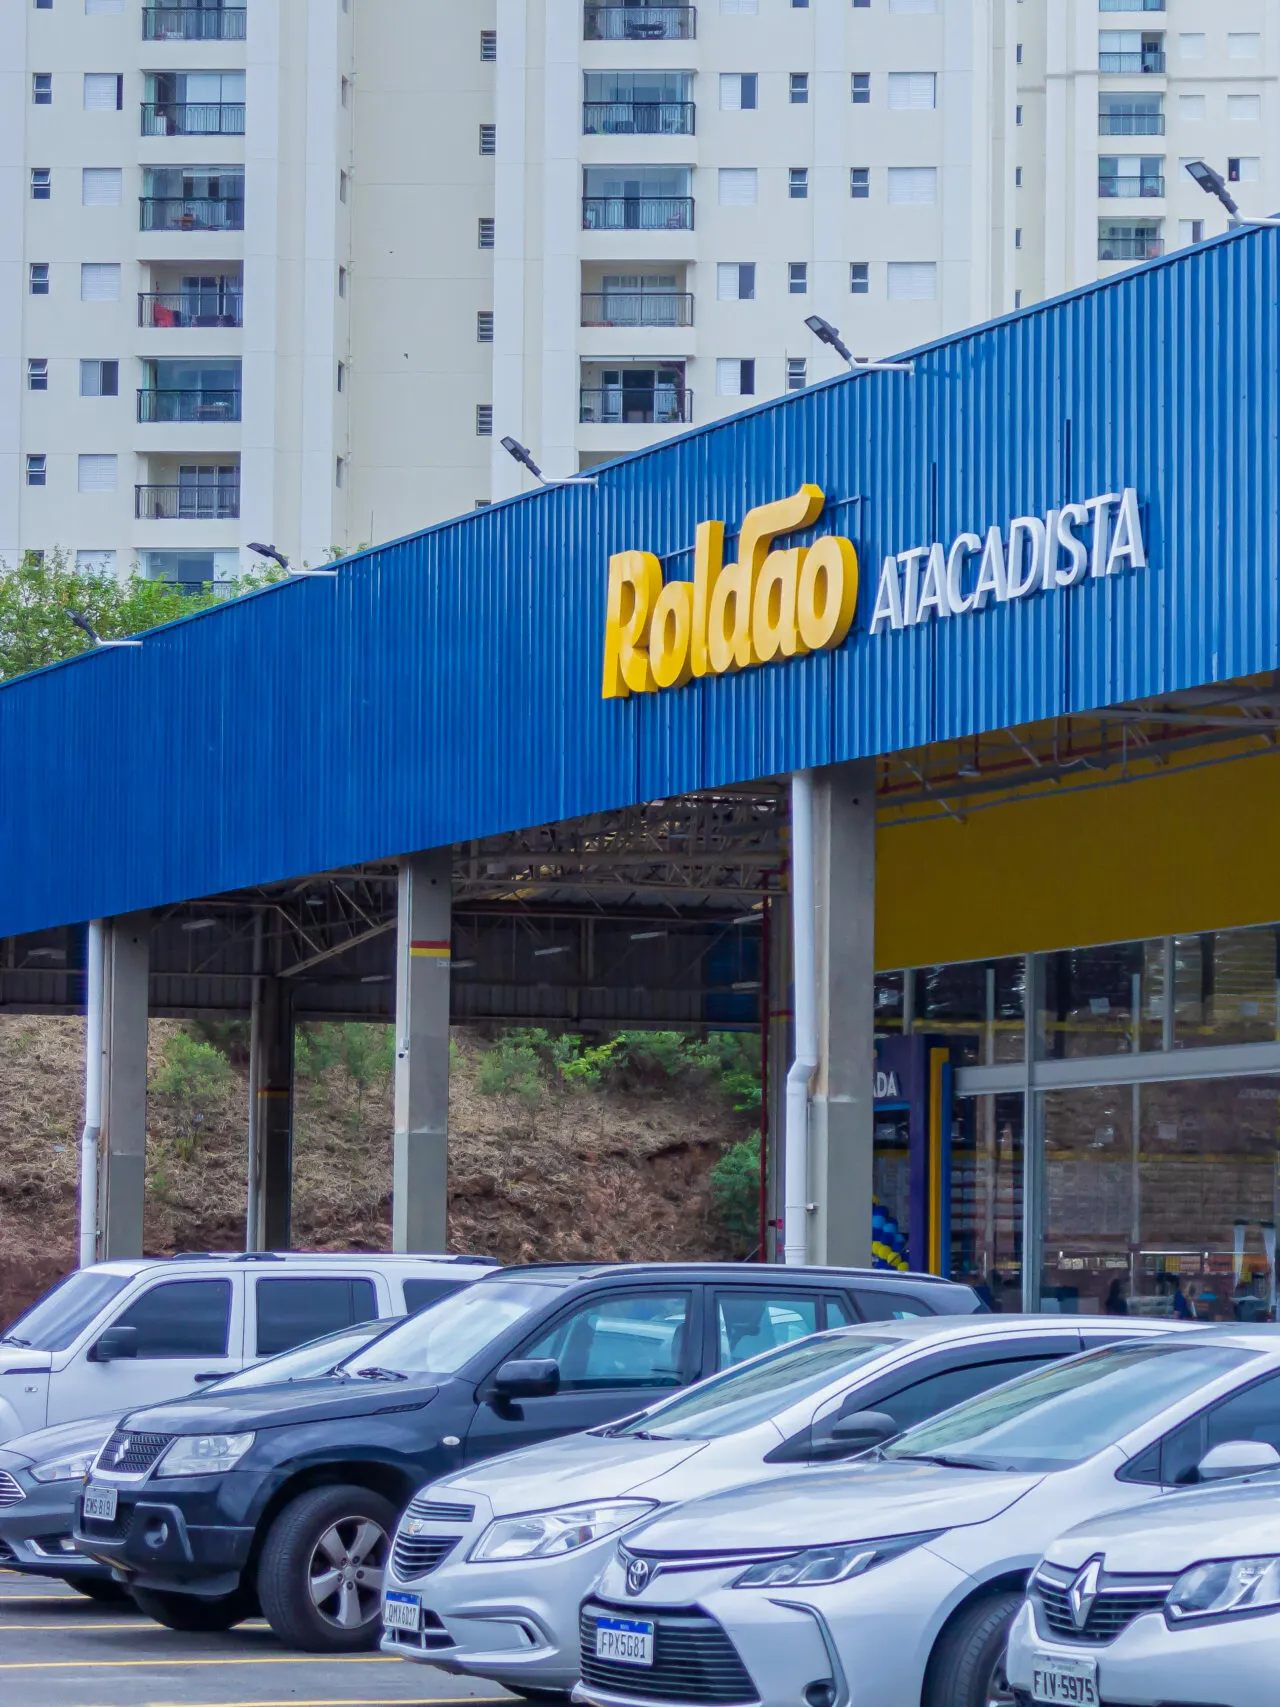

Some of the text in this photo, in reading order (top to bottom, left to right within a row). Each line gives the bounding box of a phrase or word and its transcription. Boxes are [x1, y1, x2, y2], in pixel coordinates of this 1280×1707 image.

[869, 487, 1146, 635] ATACADISTA
[601, 1631, 646, 1659] FPX5G81
[1033, 1669, 1095, 1703] FIV-5975
